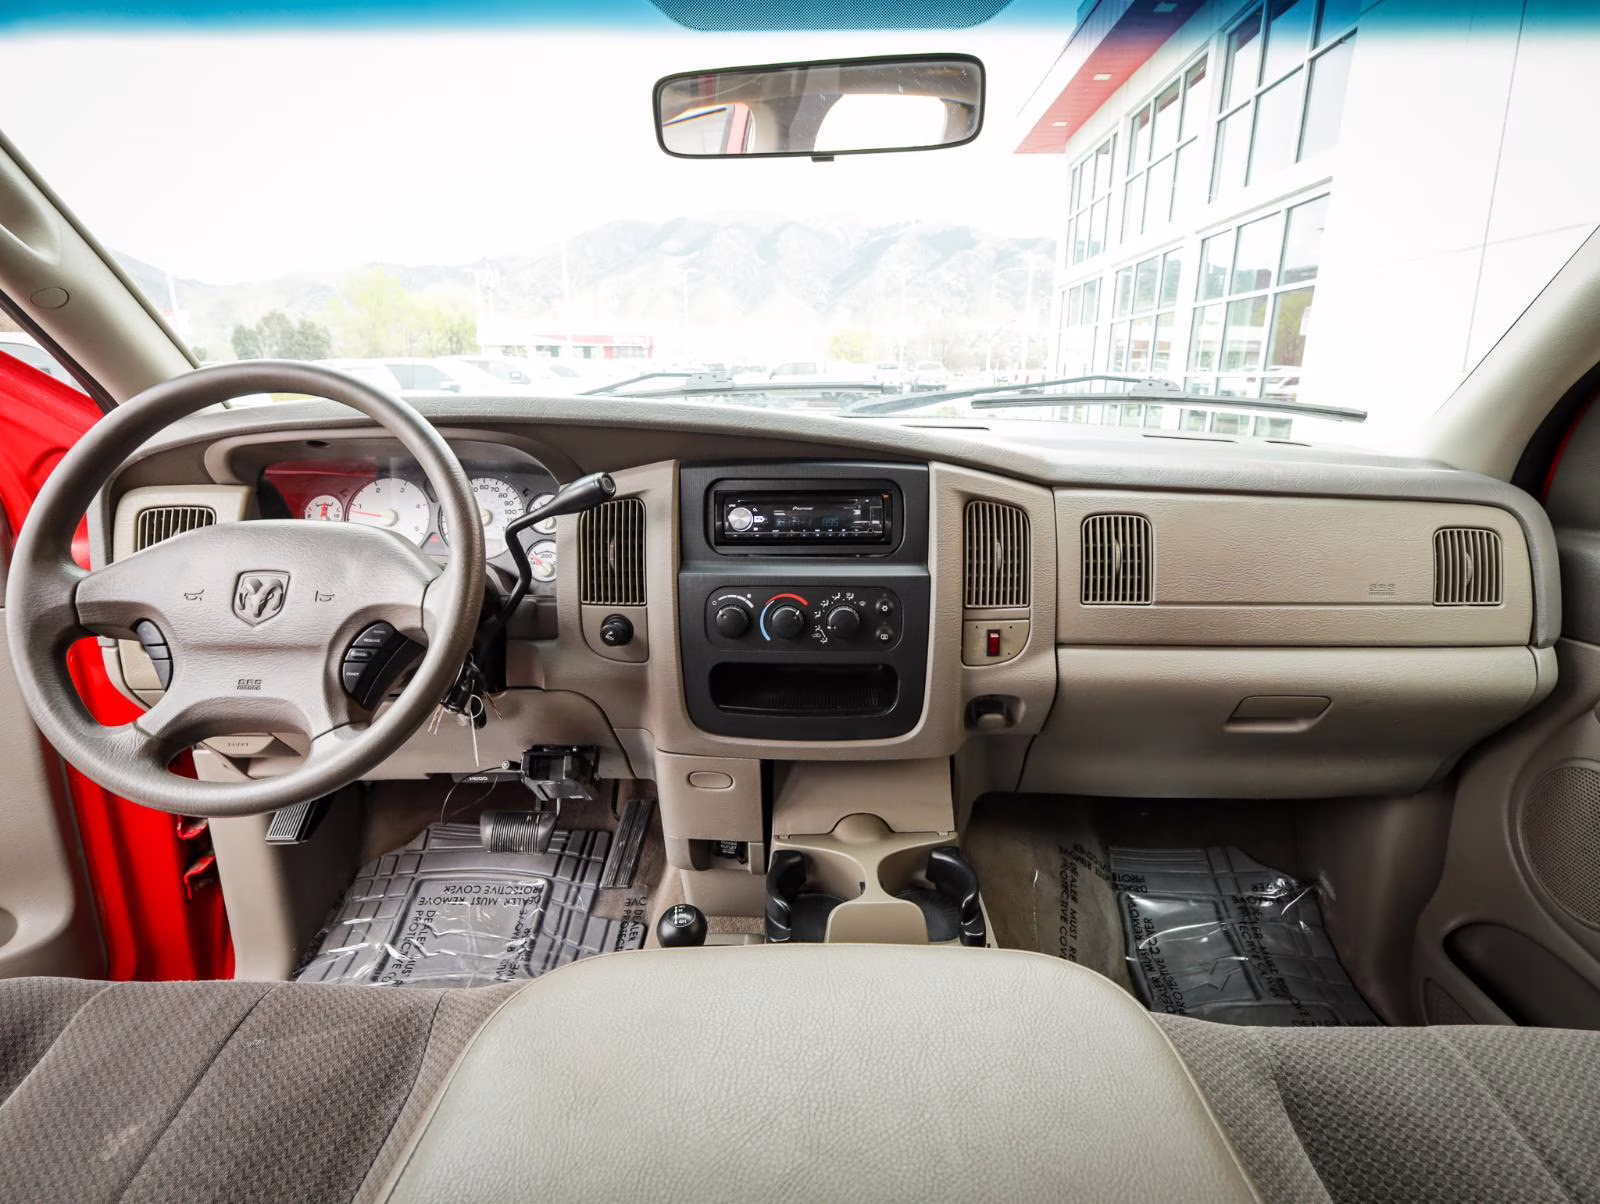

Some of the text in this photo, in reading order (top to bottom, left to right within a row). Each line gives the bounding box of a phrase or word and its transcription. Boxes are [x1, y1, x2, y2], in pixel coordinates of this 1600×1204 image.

[418, 896, 466, 906] REMOVE
[470, 896, 499, 906] MUST
[1069, 908, 1078, 940] MUST
